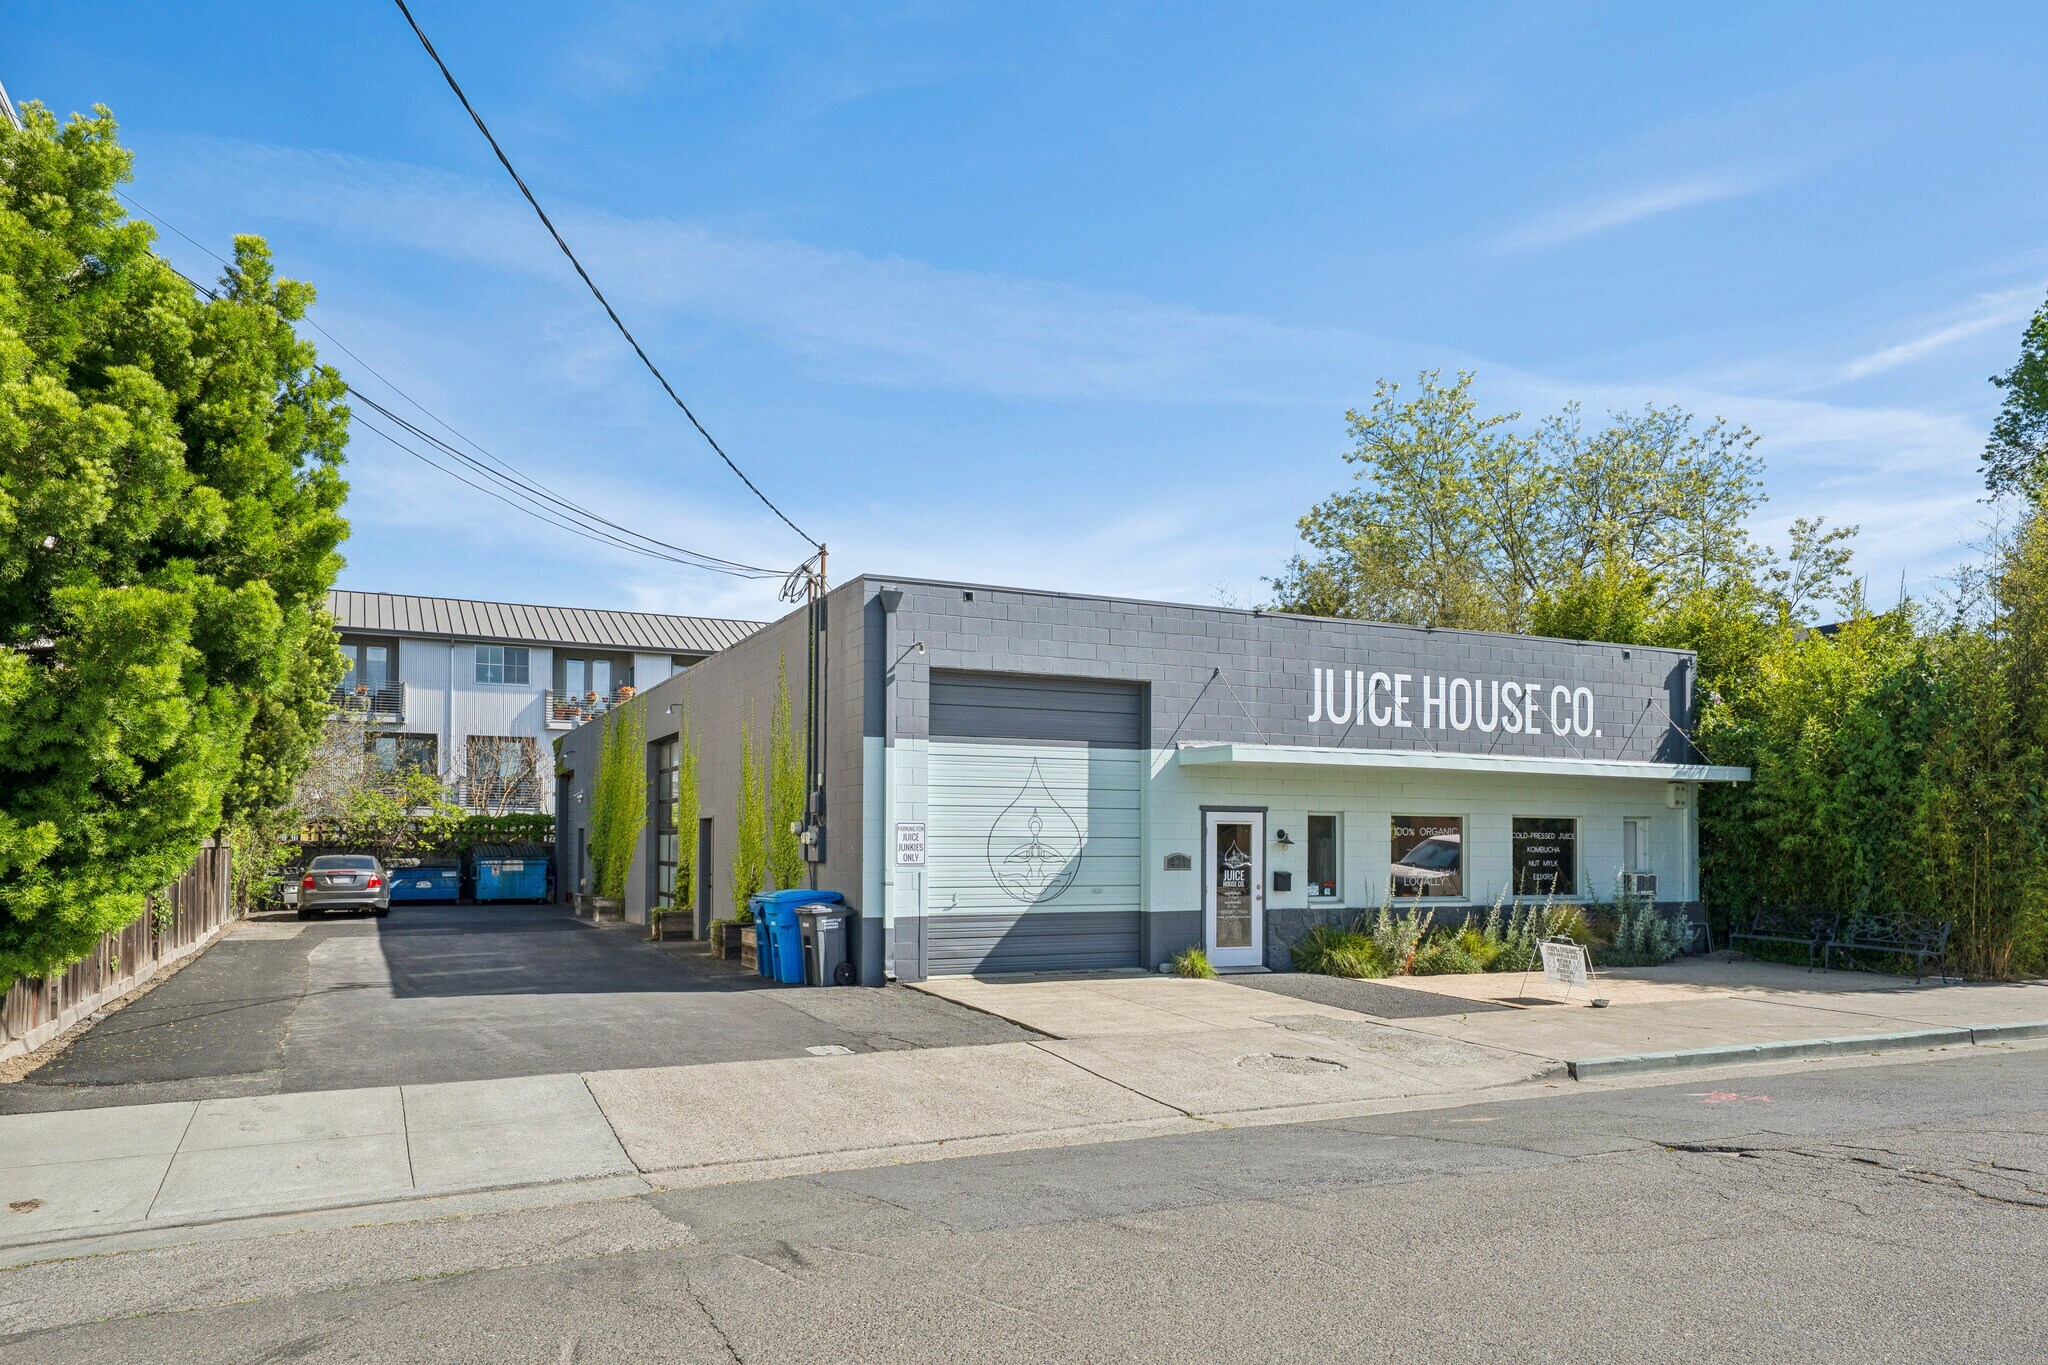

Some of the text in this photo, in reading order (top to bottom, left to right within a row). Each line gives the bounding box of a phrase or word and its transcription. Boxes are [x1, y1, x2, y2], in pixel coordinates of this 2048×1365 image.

[1308, 667, 1602, 738] JUICE HOUSE CO.
[1394, 827, 1415, 836] 100%
[902, 833, 920, 841] JUICE
[898, 844, 924, 852] JUNKIES
[903, 854, 920, 862] ONLY
[1223, 870, 1245, 881] JUICE
